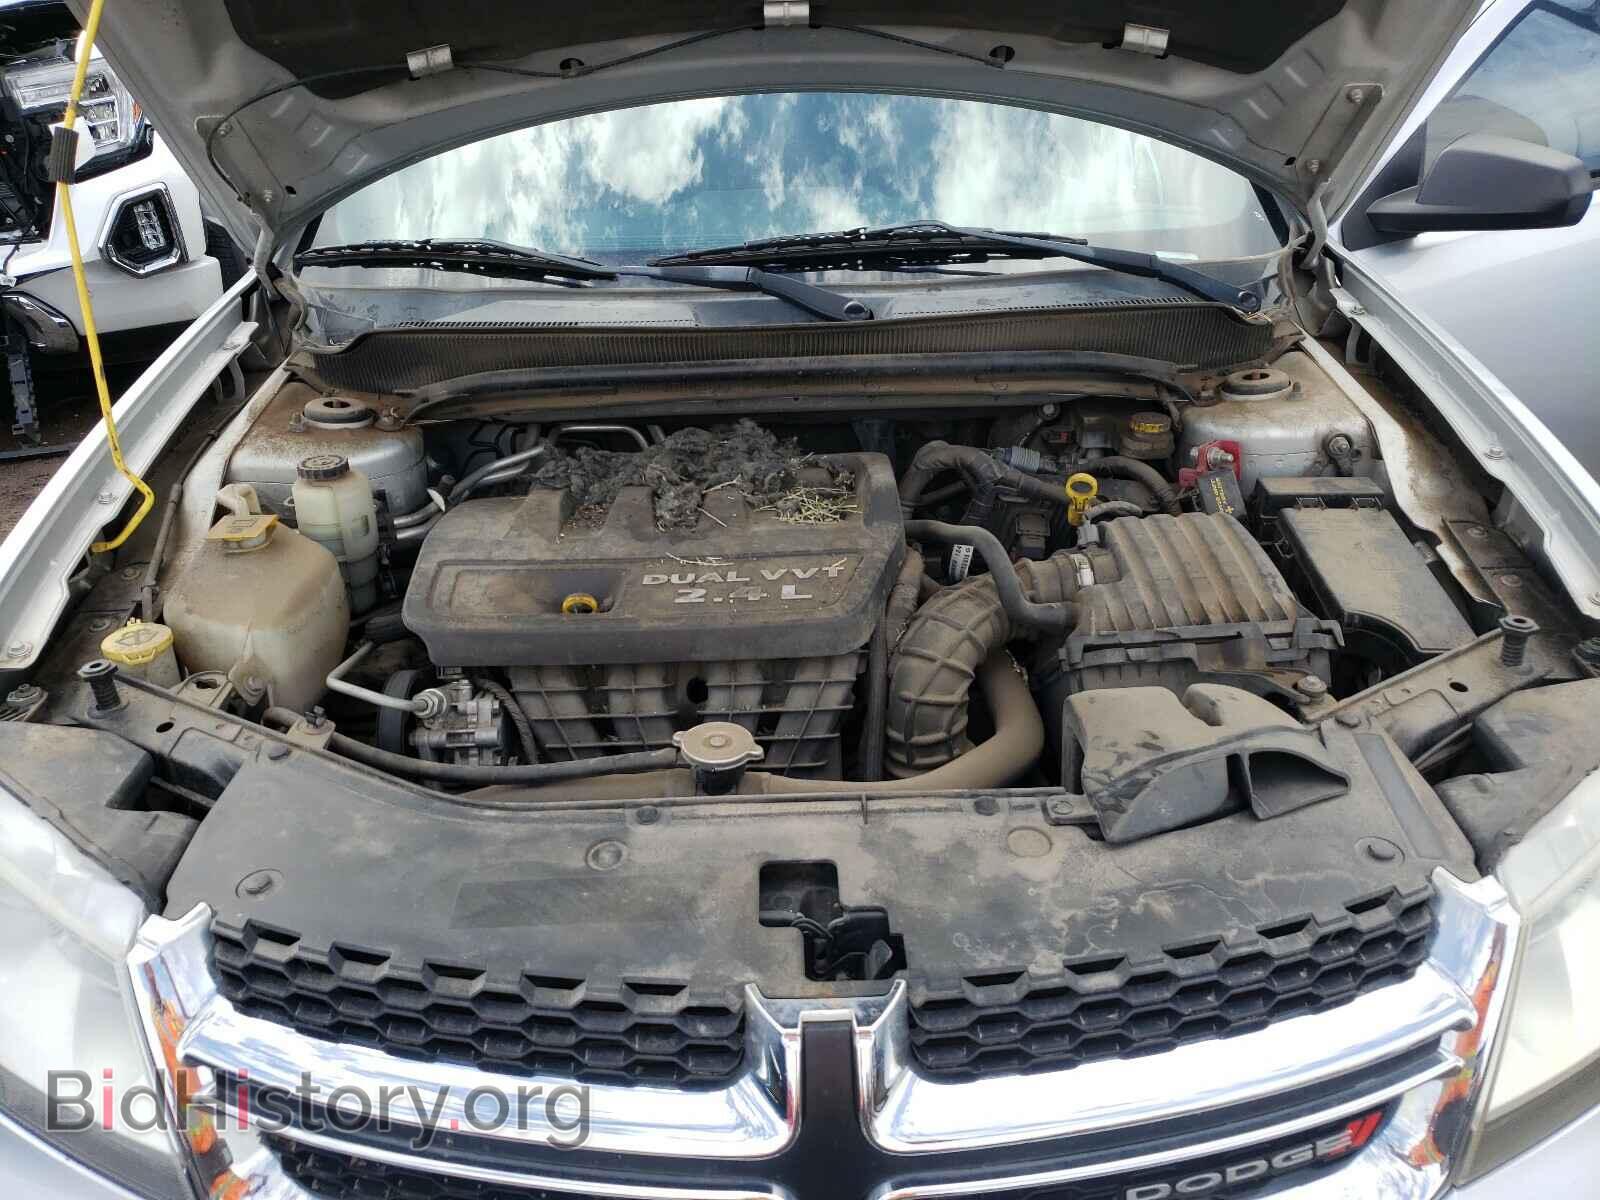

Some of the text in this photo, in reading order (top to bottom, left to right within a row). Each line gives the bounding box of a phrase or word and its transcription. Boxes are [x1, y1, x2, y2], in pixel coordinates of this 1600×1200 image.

[642, 566, 845, 585] DUAL VVT
[1125, 1129, 1353, 1200] DODGE
